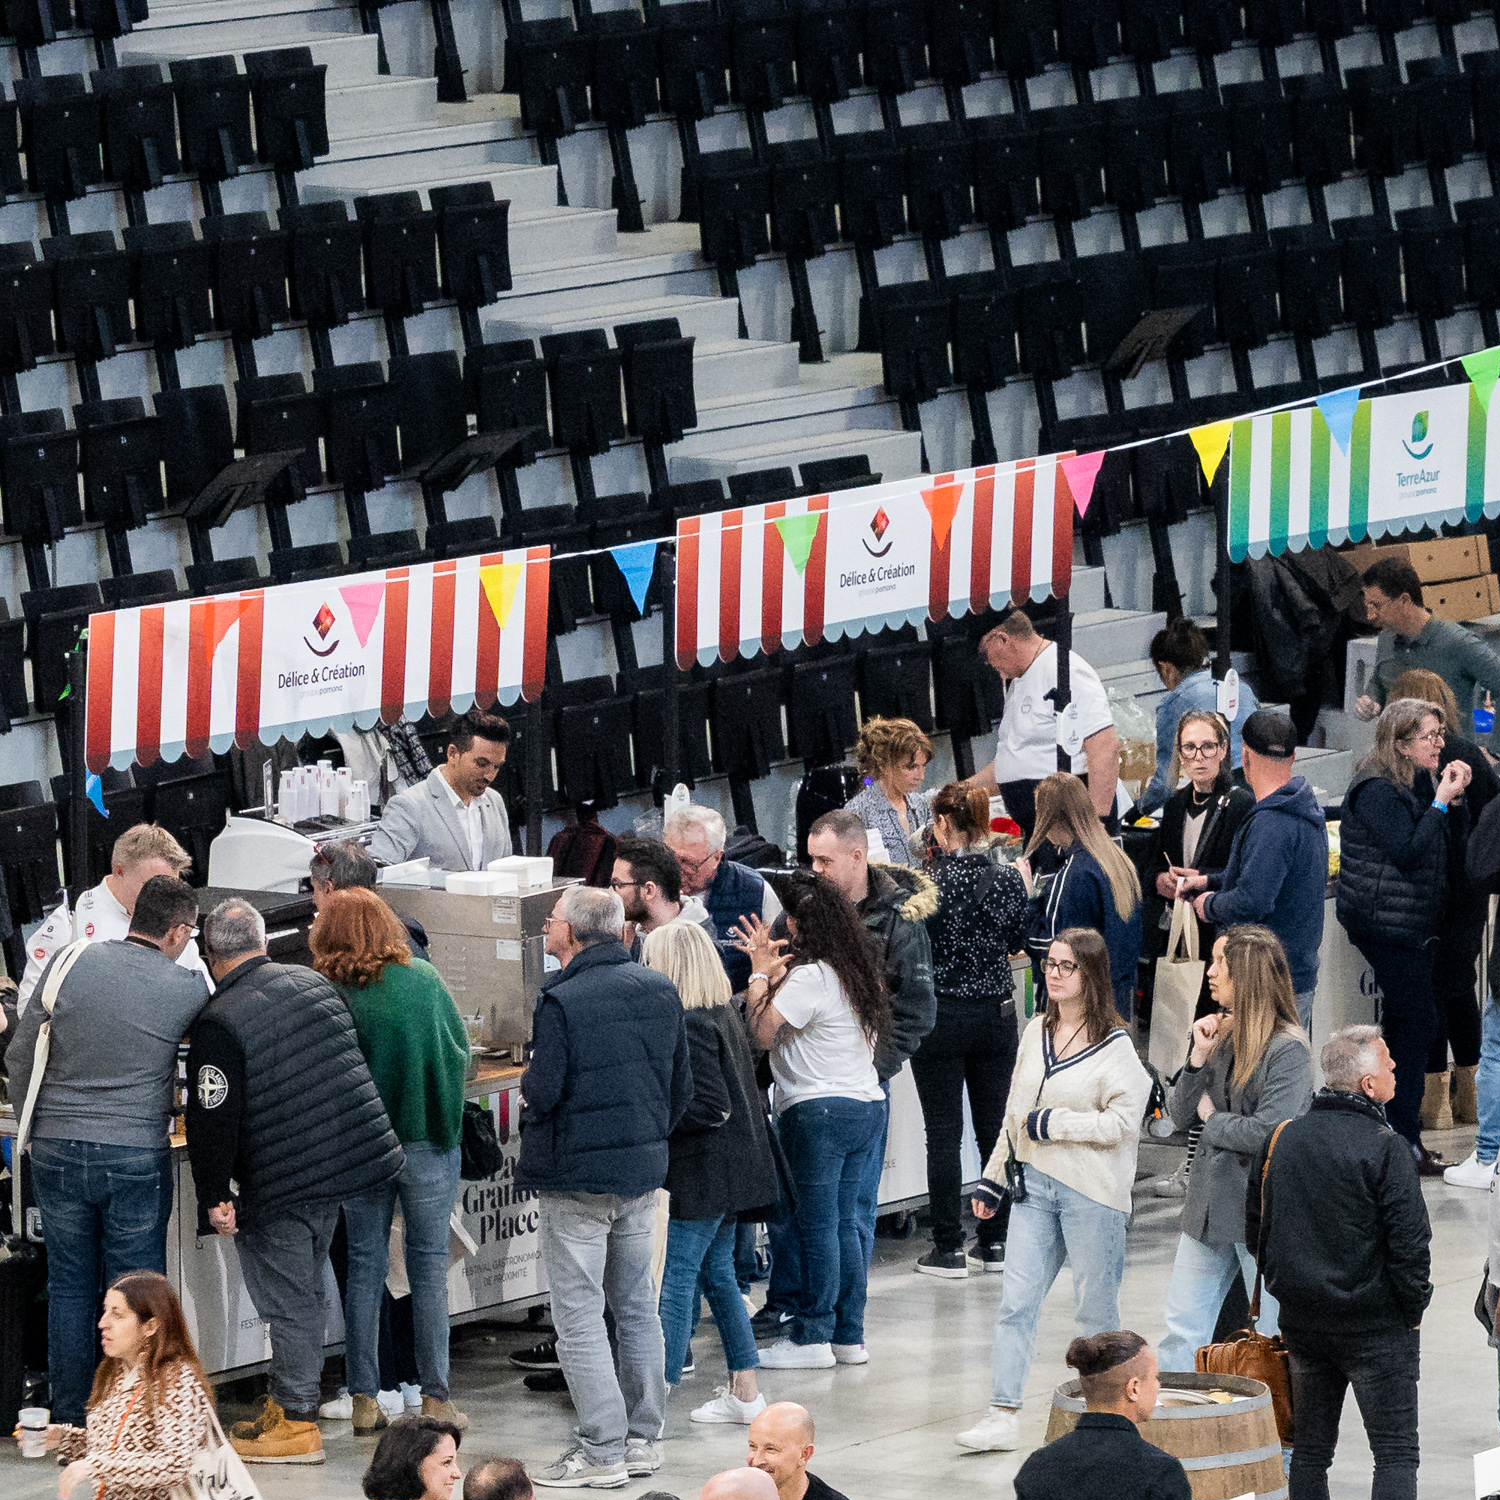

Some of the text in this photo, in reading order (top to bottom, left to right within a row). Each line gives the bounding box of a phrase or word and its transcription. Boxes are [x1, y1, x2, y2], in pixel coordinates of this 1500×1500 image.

[1396, 469, 1440, 488] TerreAzur
[840, 562, 915, 589] Délice & Création
[278, 661, 366, 690] Délice & Création
[479, 1209, 540, 1246] Place
